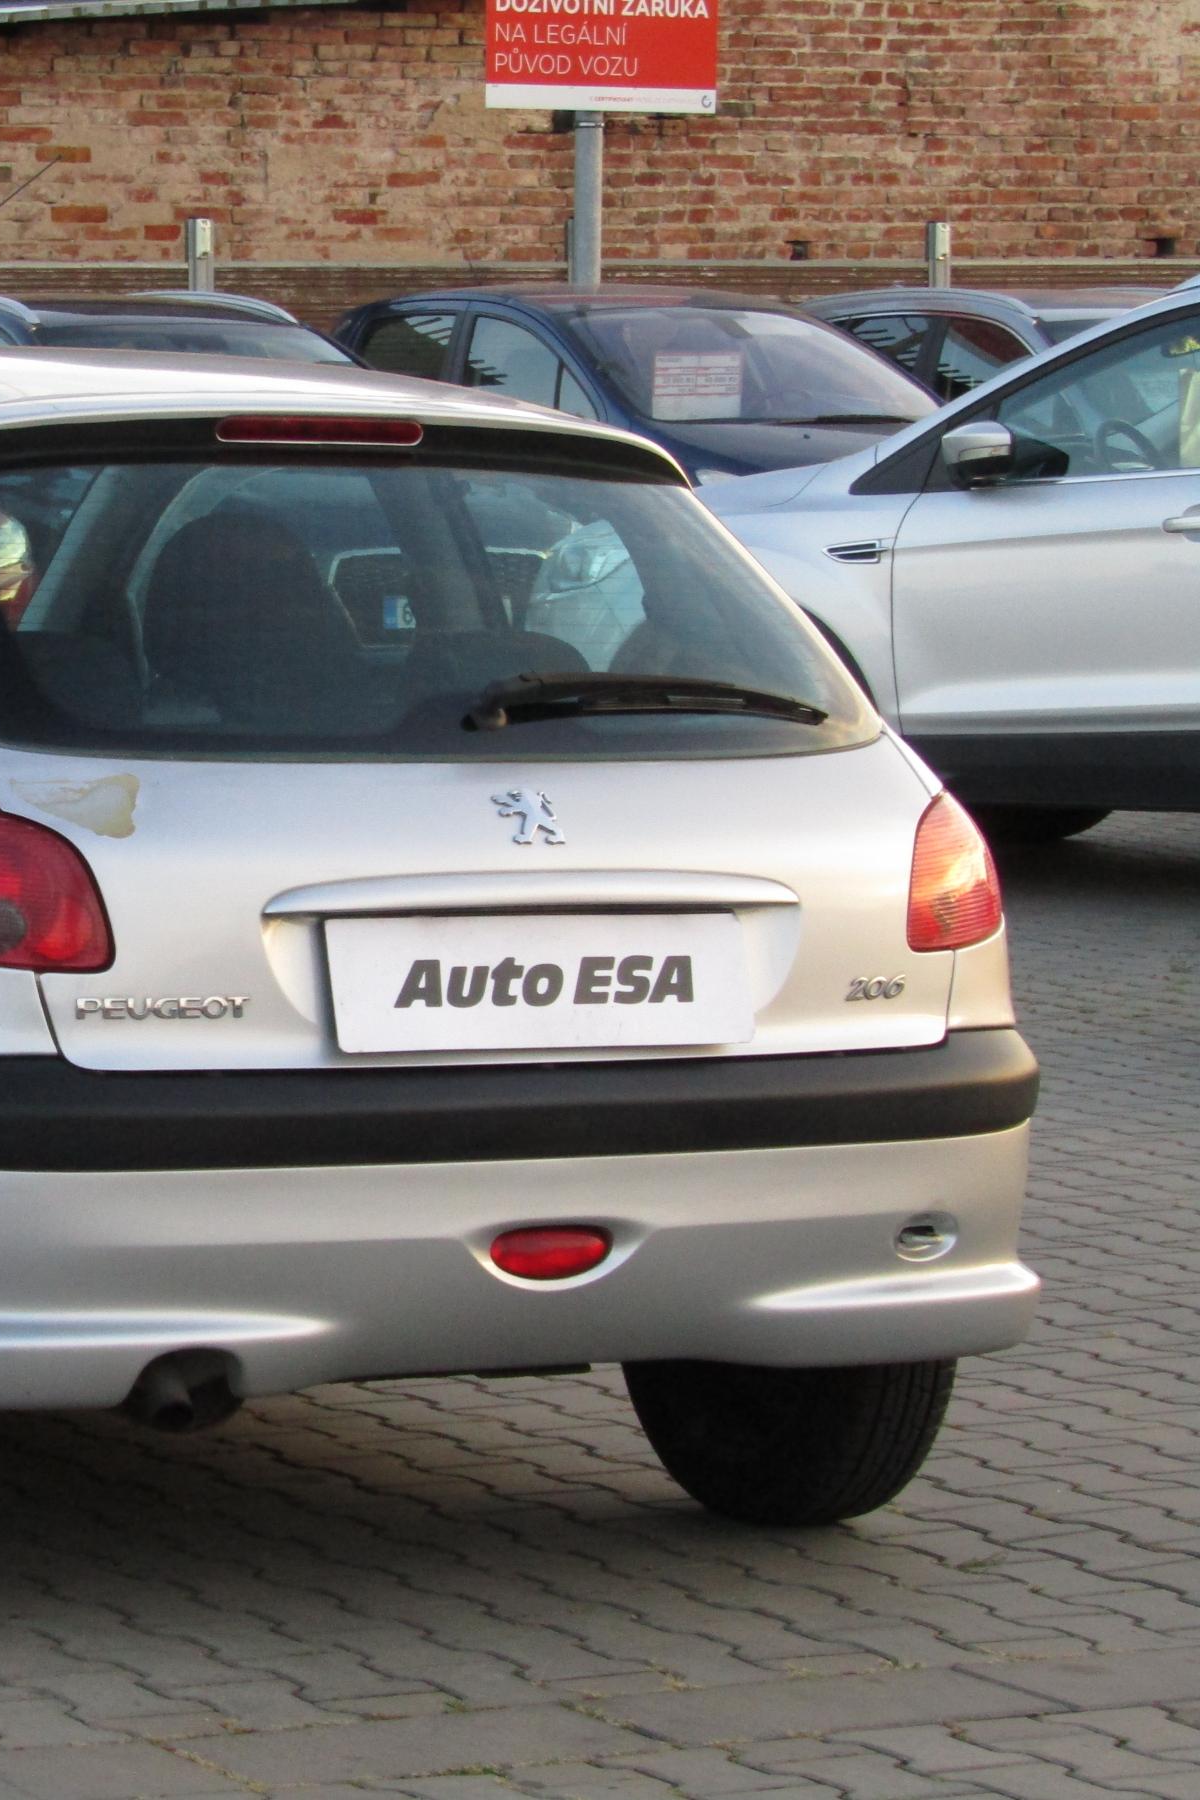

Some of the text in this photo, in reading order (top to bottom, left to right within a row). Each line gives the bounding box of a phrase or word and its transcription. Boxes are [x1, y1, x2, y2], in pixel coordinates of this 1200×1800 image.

[495, 20, 628, 46] NA LEGÁLNÍ
[494, 47, 638, 77] PŮVOD VOZU
[394, 955, 694, 1008] Auto ESA
[844, 974, 906, 1002] 206
[75, 995, 249, 1020] PEUGEOT
